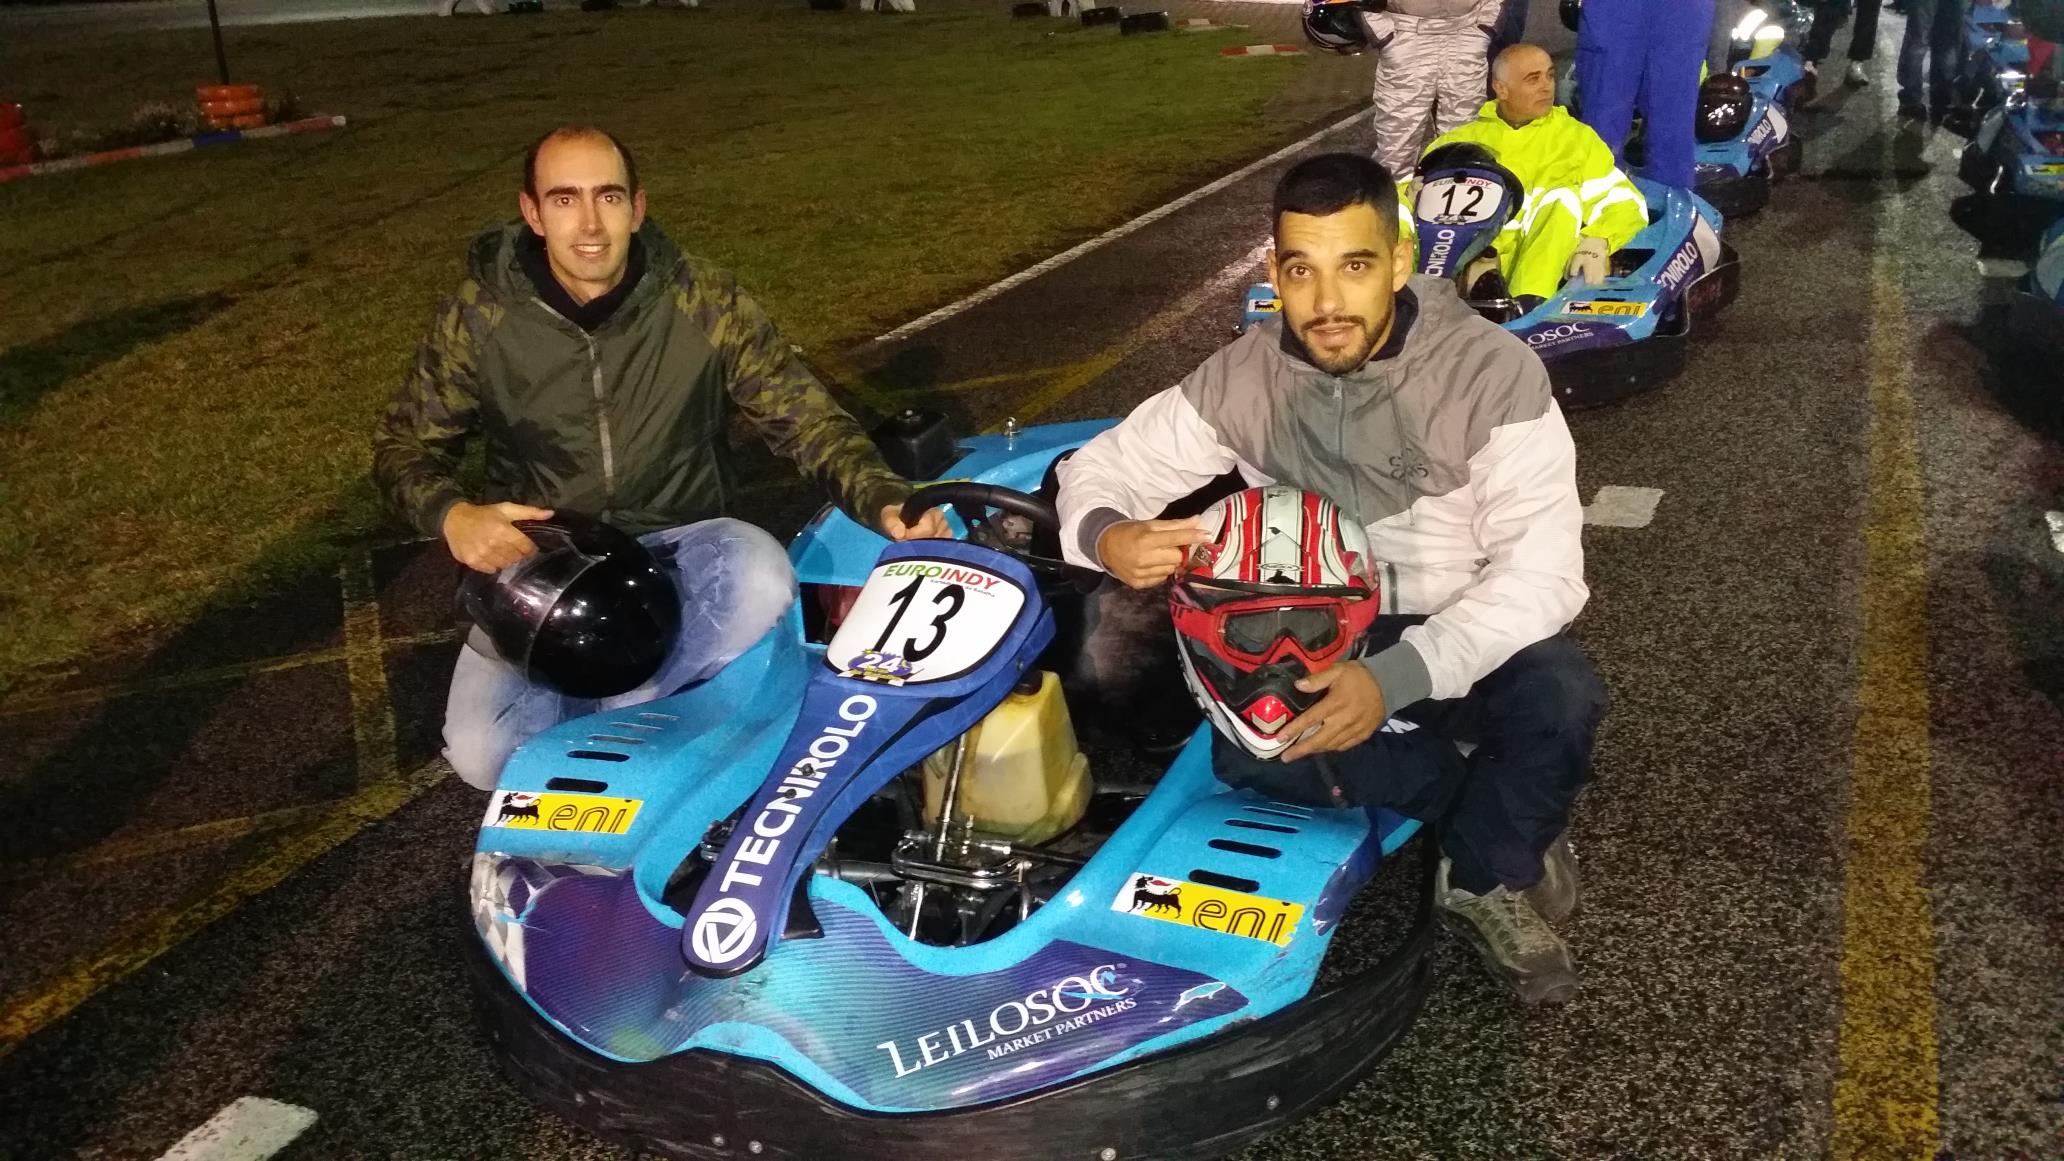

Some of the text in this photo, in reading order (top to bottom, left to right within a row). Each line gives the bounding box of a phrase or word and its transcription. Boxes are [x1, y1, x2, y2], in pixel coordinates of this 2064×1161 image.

[1441, 185, 1484, 216] 12
[1598, 302, 1641, 316] eni
[1527, 321, 1590, 345] OSOC
[883, 564, 1001, 590] EUROINDY
[871, 574, 966, 663] 13
[856, 653, 901, 672] 24
[719, 694, 878, 893] TECNIROLO
[547, 799, 632, 834] eni
[1193, 901, 1291, 944] eni
[876, 963, 1129, 1079] LEILOSOC
[987, 997, 1137, 1060] MARKET PARTNERS
